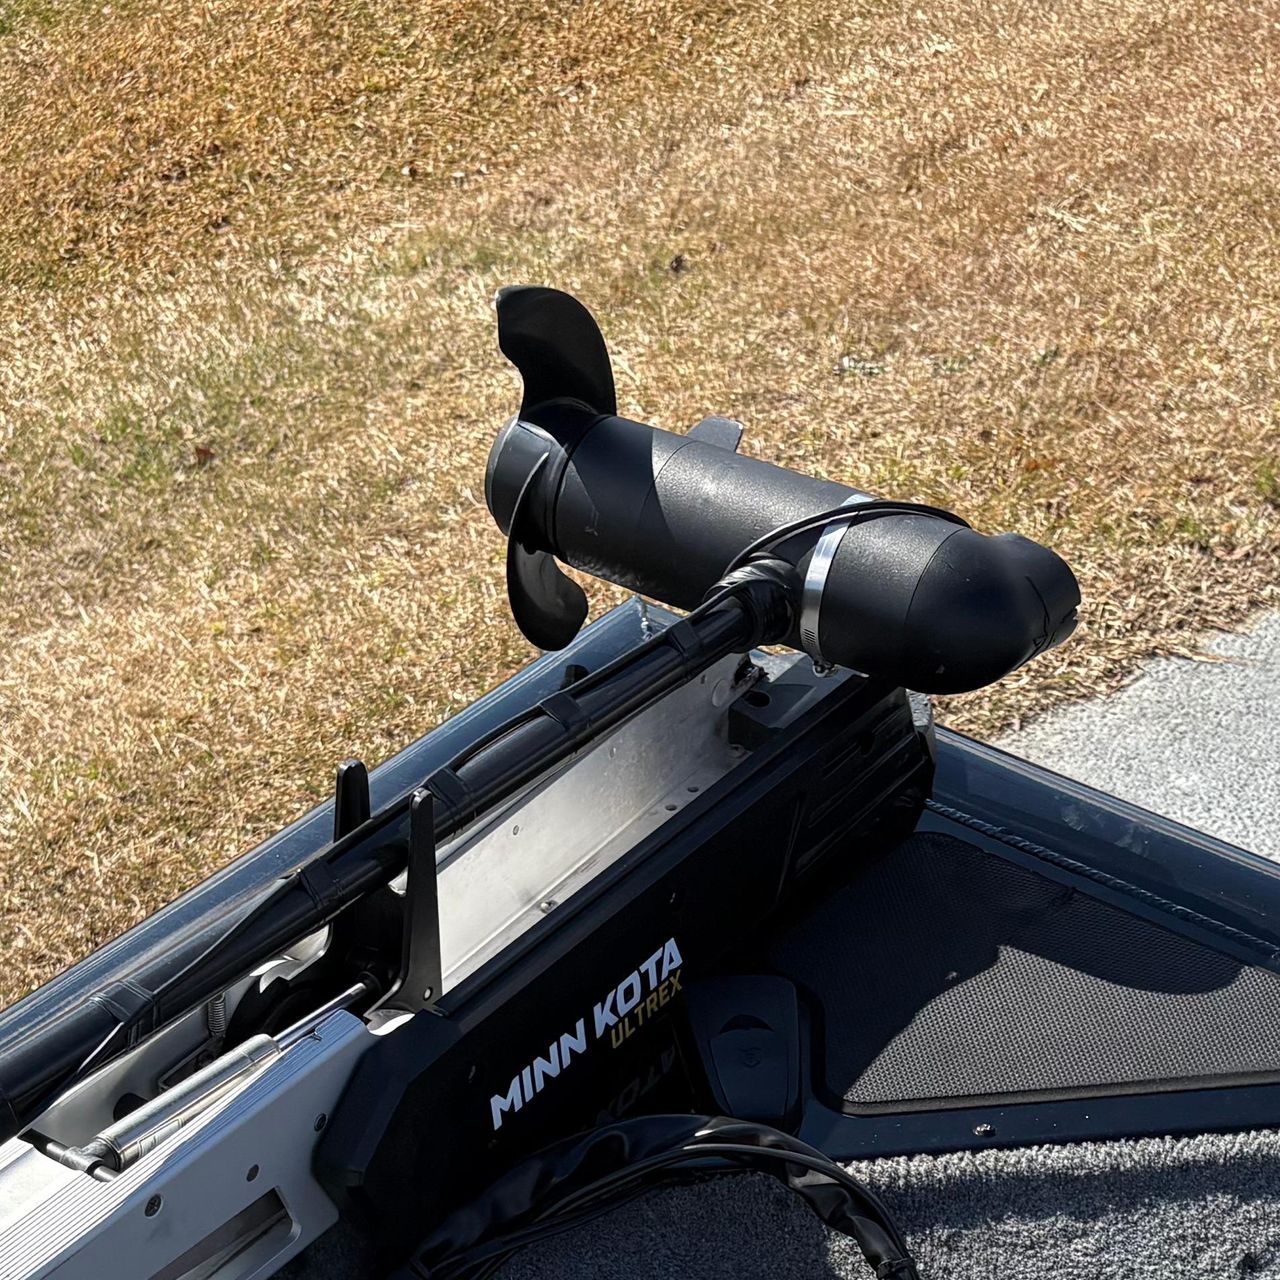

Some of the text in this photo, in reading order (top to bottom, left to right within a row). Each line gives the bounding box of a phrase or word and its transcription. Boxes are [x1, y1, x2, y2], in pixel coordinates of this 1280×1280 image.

[489, 1017, 587, 1131] MINN
[593, 937, 684, 1039] KOTA
[610, 969, 682, 1049] ULTREX
